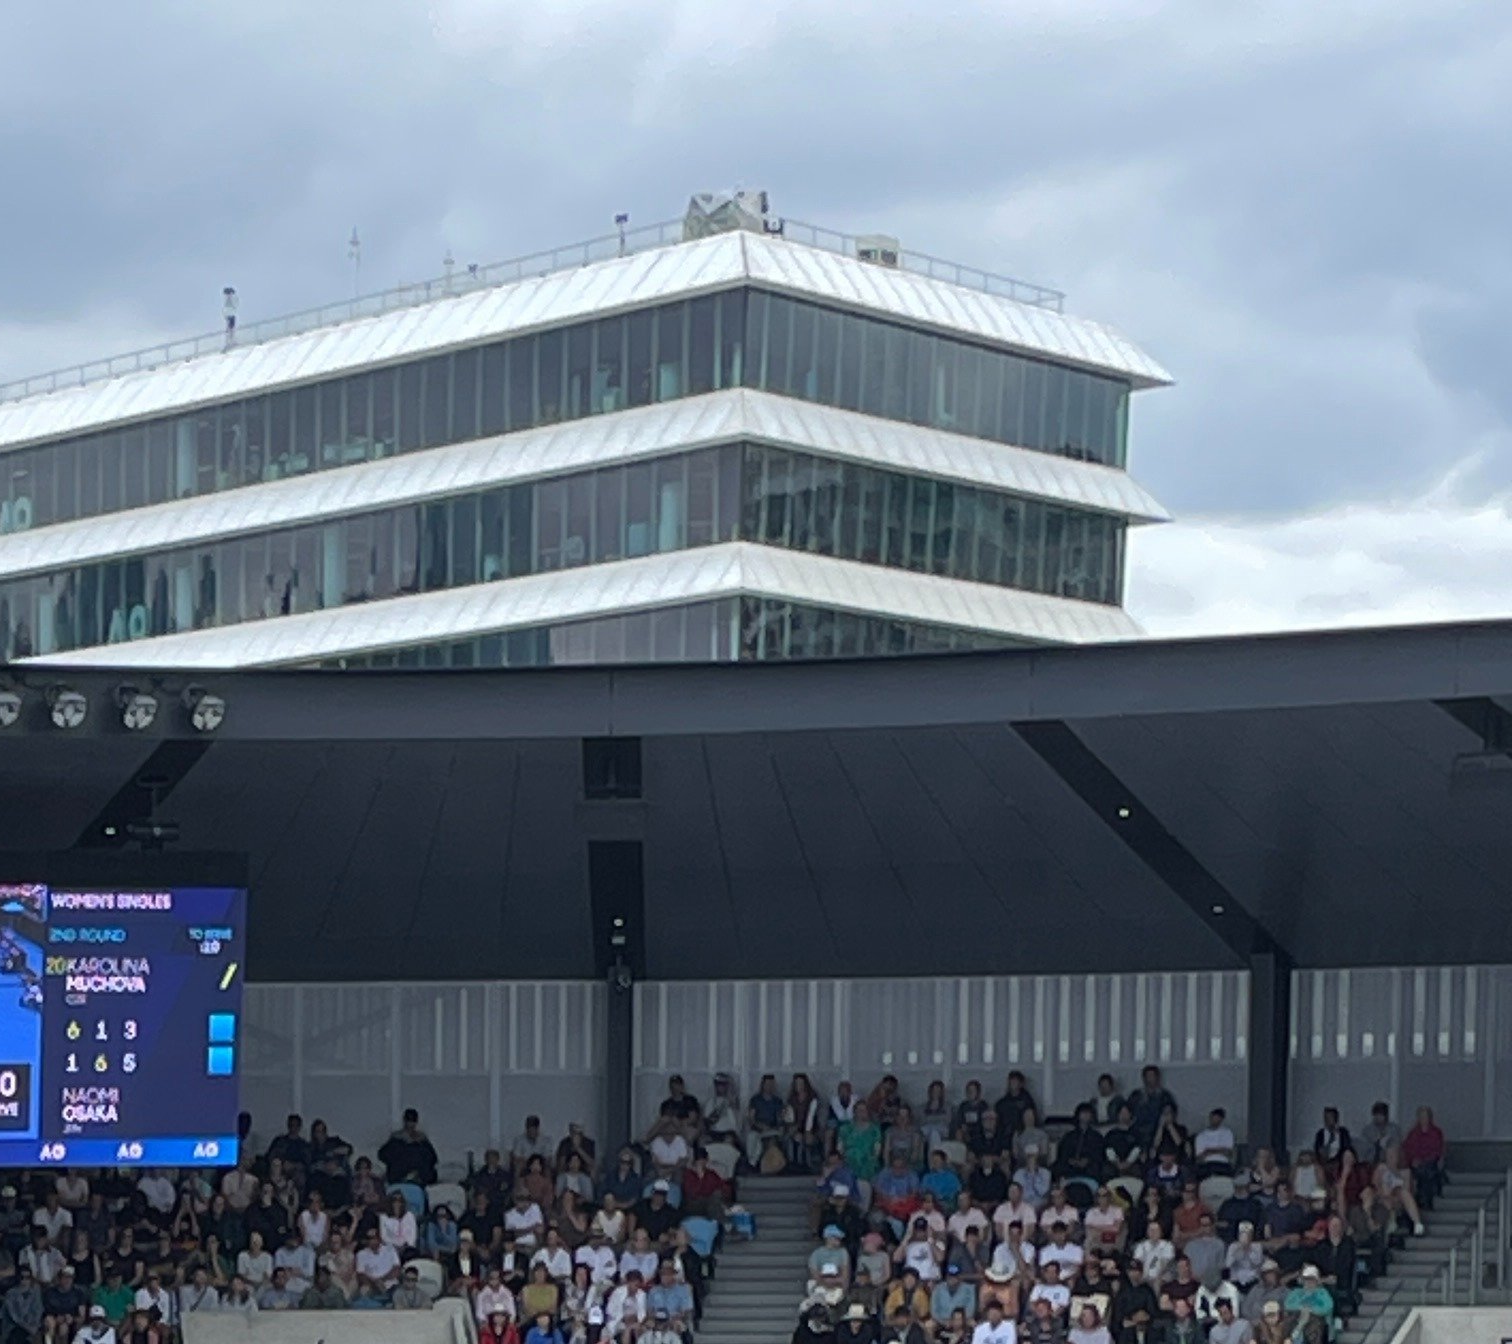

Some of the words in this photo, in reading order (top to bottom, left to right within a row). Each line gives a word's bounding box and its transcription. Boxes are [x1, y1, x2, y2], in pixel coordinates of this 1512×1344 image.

[65, 957, 150, 976] KAROLINA
[66, 1019, 81, 1040] 6
[95, 1019, 108, 1041] 1
[123, 1019, 138, 1041] 3
[65, 1052, 79, 1072] 1
[94, 1052, 108, 1072] 6
[122, 1052, 138, 1073] 5
[62, 1087, 120, 1105] NAOMI
[62, 1104, 119, 1123] OSAKA
